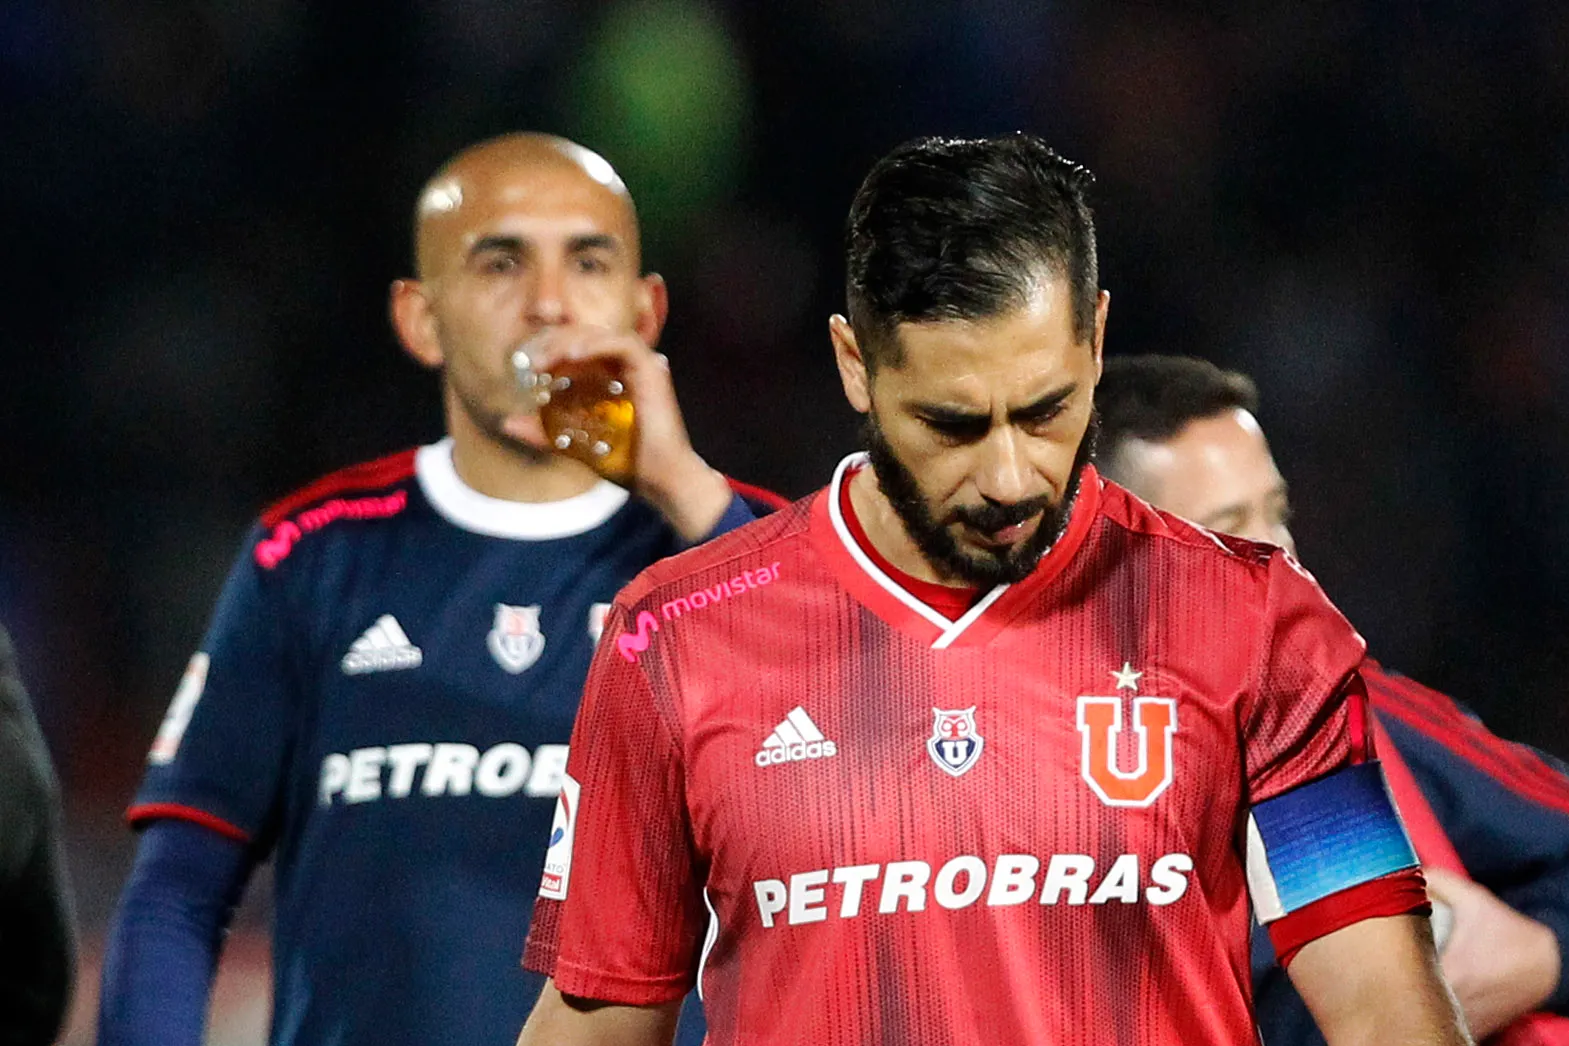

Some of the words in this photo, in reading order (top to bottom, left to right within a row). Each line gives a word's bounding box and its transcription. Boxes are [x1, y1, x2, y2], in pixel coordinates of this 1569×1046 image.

[661, 562, 782, 621] movistar
[317, 742, 570, 808] PETROB
[755, 738, 838, 768] adidas
[1076, 695, 1178, 808] U
[753, 853, 1194, 928] PETROBRAS
